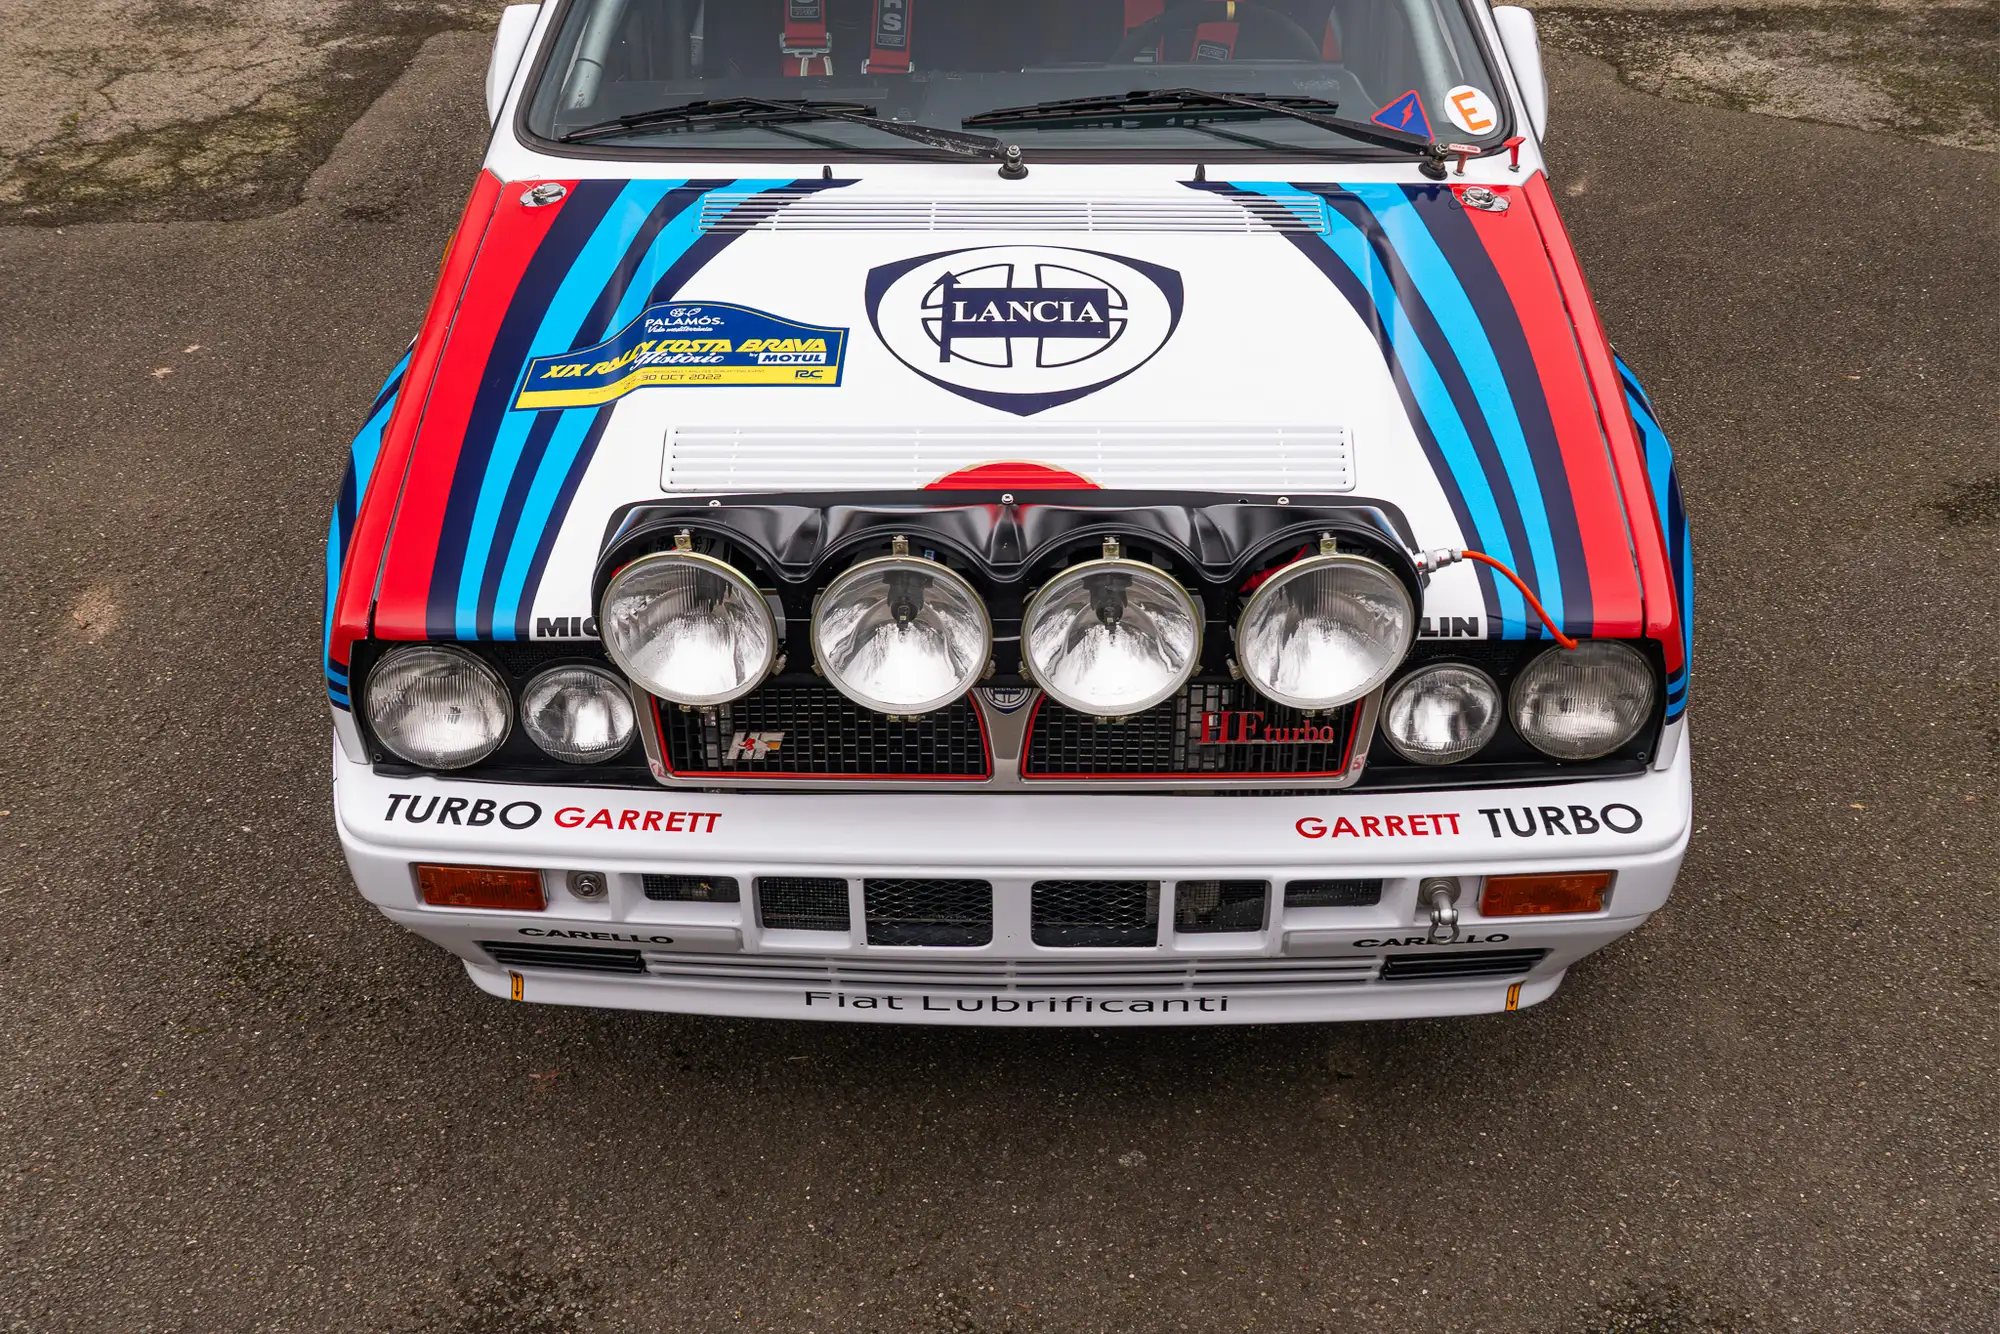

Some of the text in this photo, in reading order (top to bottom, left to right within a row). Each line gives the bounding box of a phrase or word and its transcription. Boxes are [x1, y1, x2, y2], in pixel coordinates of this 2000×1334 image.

[1451, 91, 1492, 131] E
[952, 301, 1103, 323] LANCIA
[541, 339, 827, 378] XIX RALLY COSTA BRAVA
[762, 354, 822, 362] MOTUL
[1198, 710, 1334, 744] HF turbo
[384, 793, 722, 833] TURBO GARRETT
[1295, 803, 1643, 839] GARRETT TURBO
[518, 927, 674, 944] CARELLO
[804, 991, 1228, 1013] Fiat Lubrificanti
